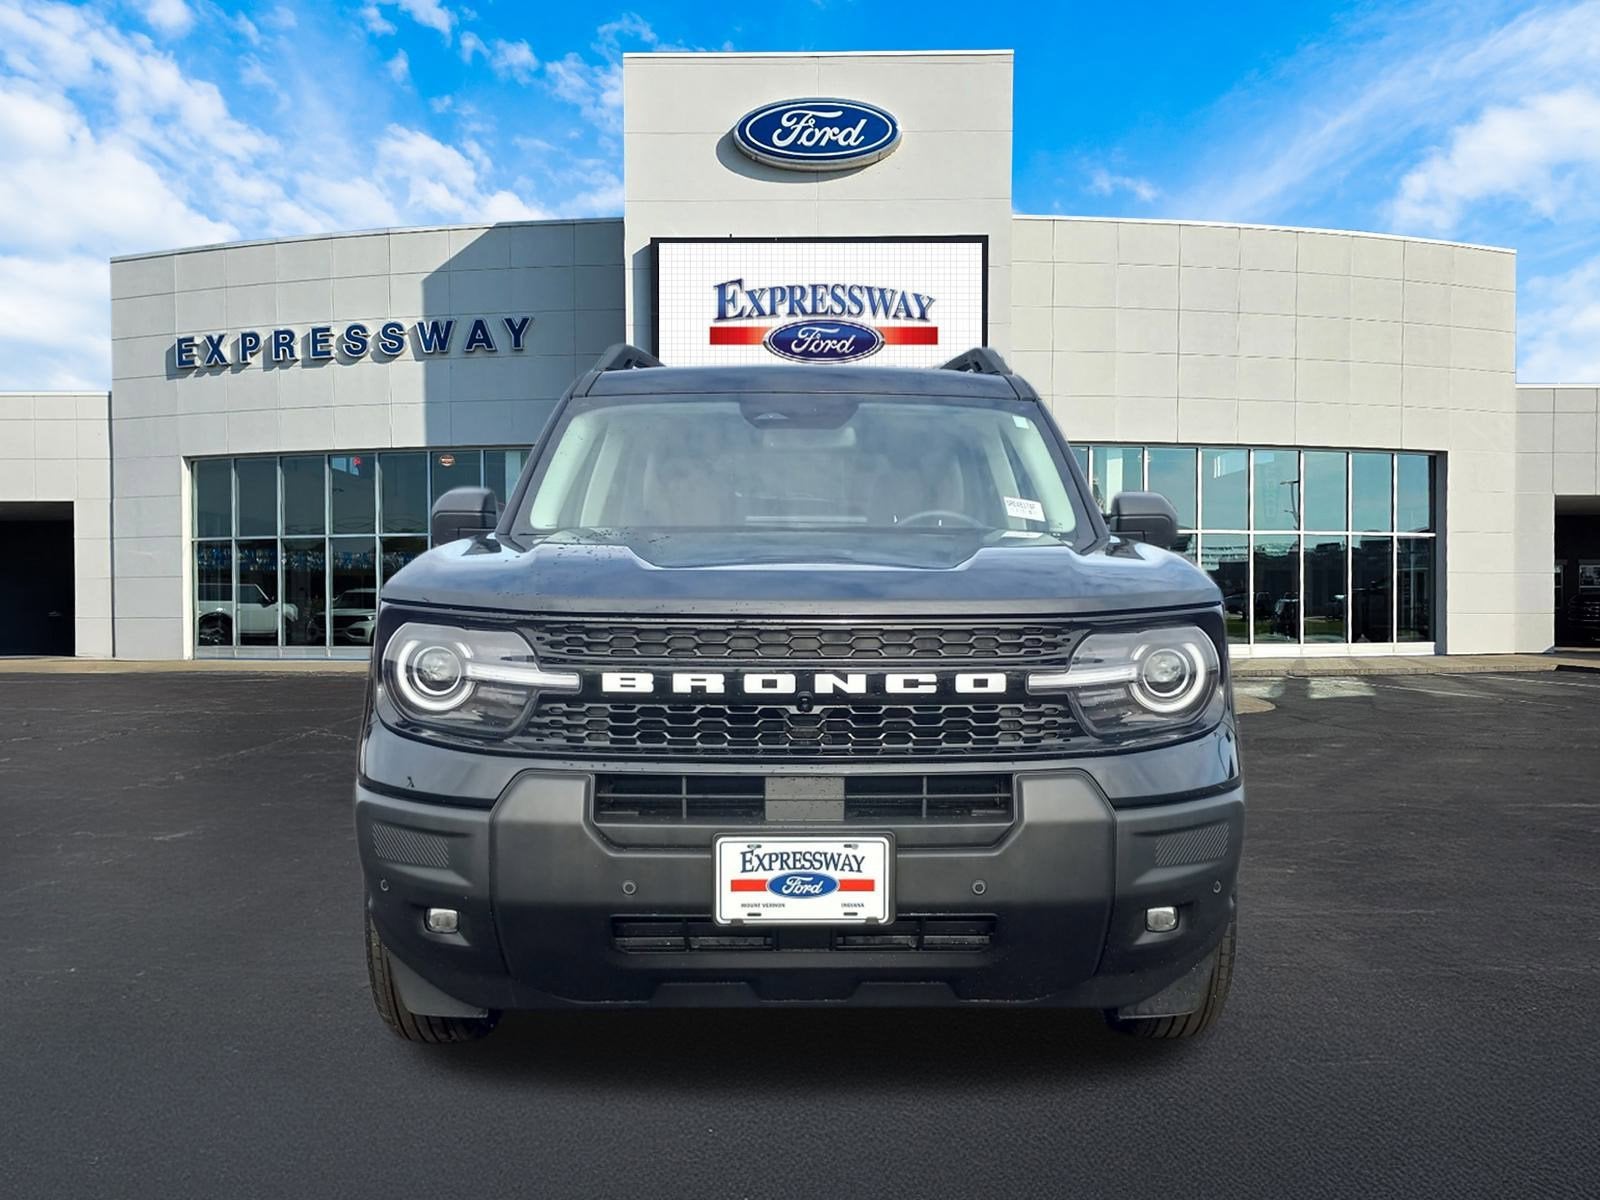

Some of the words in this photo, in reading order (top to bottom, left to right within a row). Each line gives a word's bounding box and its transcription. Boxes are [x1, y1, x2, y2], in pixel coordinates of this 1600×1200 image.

[772, 109, 868, 147] Ford
[713, 278, 936, 322] EXPRESSWAY
[175, 315, 533, 370] EXPRESSWAY
[790, 326, 857, 353] Ford
[601, 672, 1008, 694] BRONCO
[740, 849, 866, 873] EXPRESSWAY
[781, 875, 824, 895] Ford
